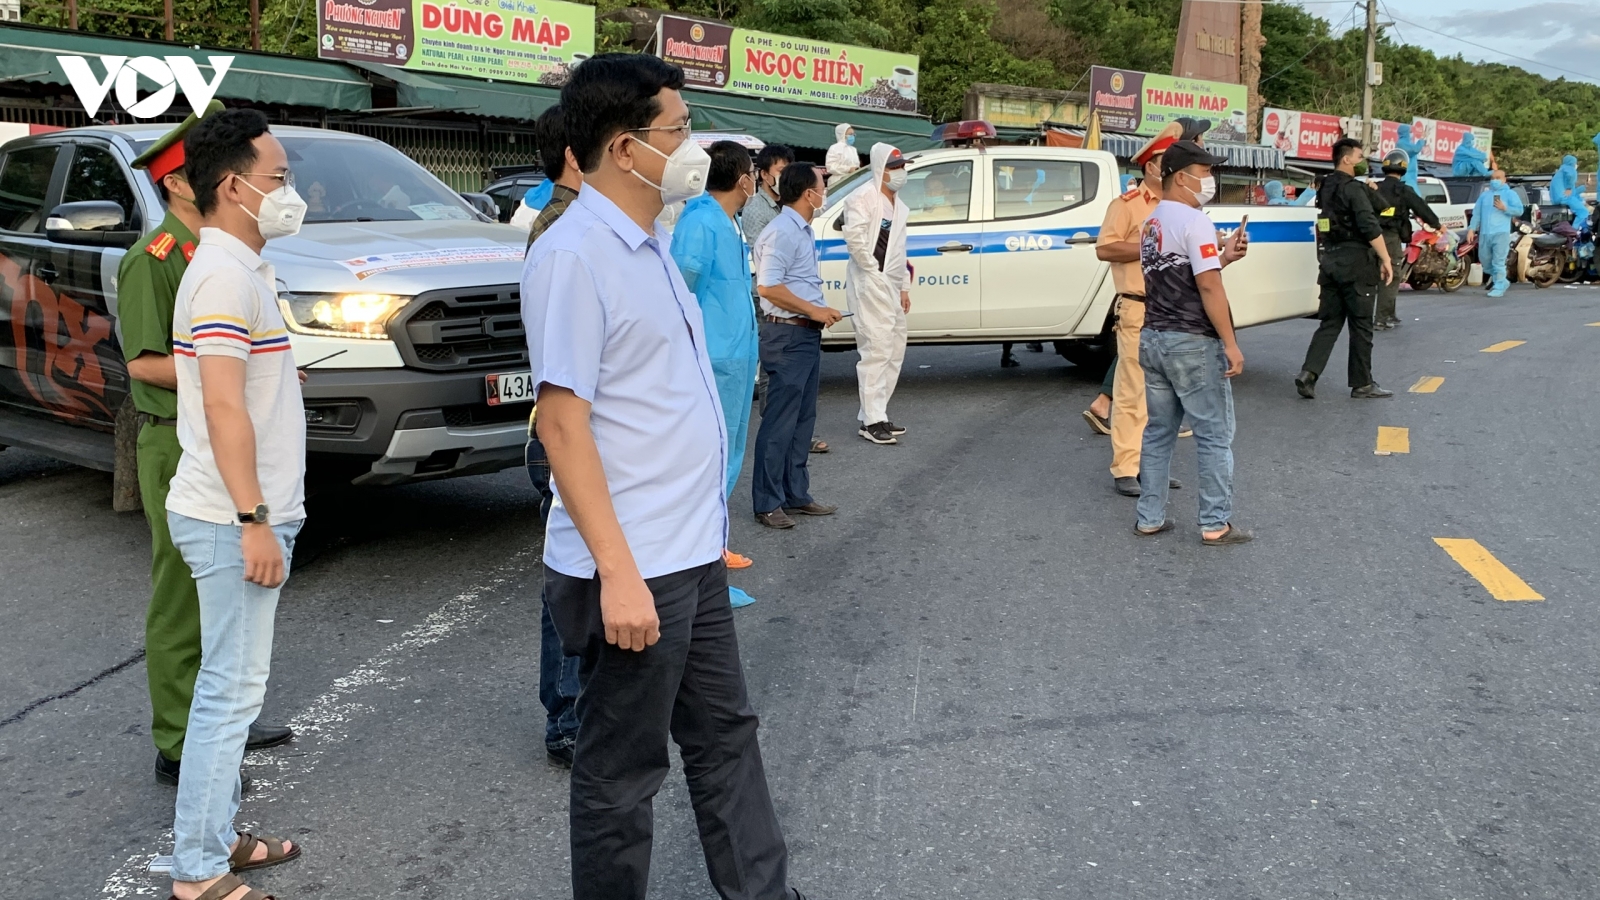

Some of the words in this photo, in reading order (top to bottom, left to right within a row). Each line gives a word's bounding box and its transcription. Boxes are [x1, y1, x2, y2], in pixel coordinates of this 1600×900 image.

[422, 3, 503, 38] DŨNG
[511, 17, 570, 52] MẬP
[421, 48, 446, 59] NATURAL
[447, 52, 464, 61] PEARL
[471, 55, 487, 64] FARM
[487, 57, 504, 66] PEARL
[794, 43, 809, 52] LƯU
[812, 45, 831, 56] NIỆM
[745, 48, 807, 85] NGỌC
[812, 50, 864, 87] HIỀN
[810, 90, 838, 100] MOBILE:
[1198, 93, 1229, 115] MẬP
[1300, 130, 1320, 149] CHỊ
[1005, 235, 1053, 252] GIAO
[918, 274, 969, 286] POLICE
[503, 375, 534, 399] 43A
